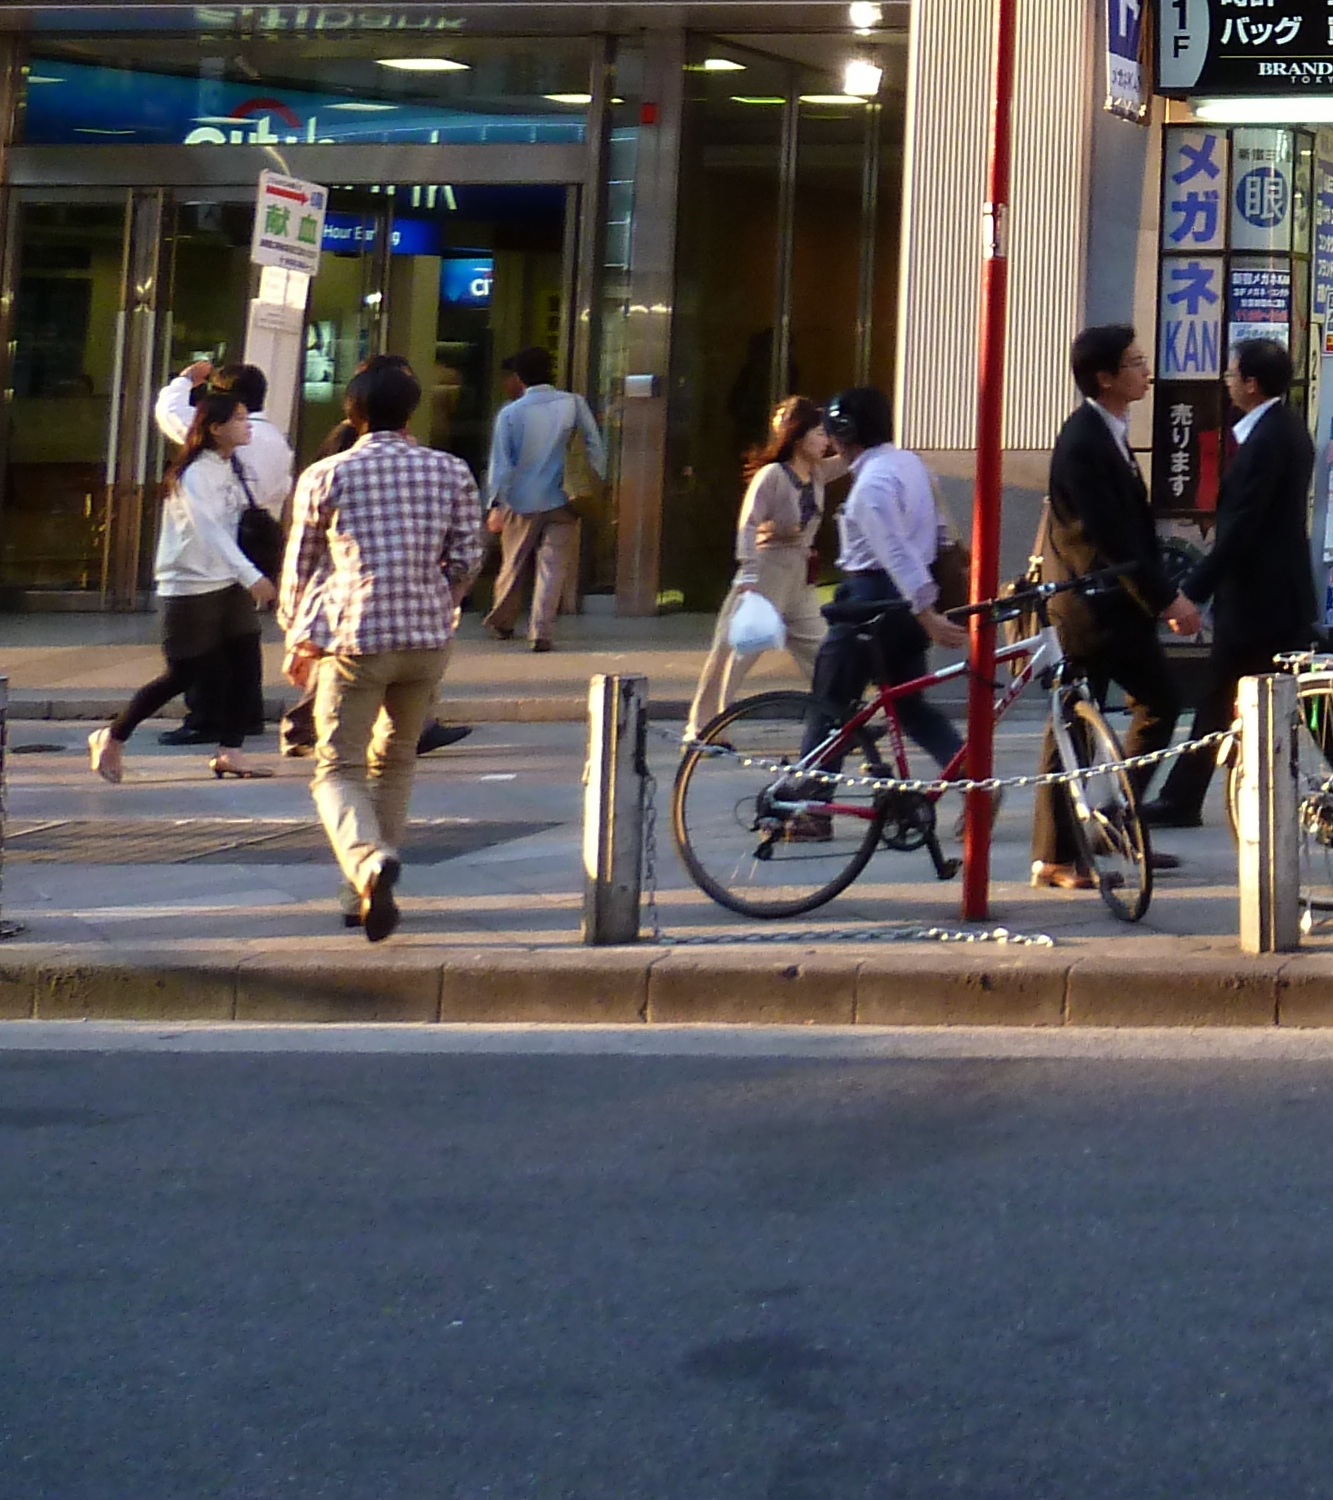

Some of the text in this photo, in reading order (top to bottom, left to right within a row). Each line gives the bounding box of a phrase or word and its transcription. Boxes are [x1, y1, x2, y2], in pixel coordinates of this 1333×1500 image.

[1221, 15, 1302, 46] バッグ
[1258, 62, 1333, 77] BRAND
[1245, 176, 1284, 219] 眼
[323, 223, 353, 239] Hour
[1168, 403, 1194, 497] 売ります
